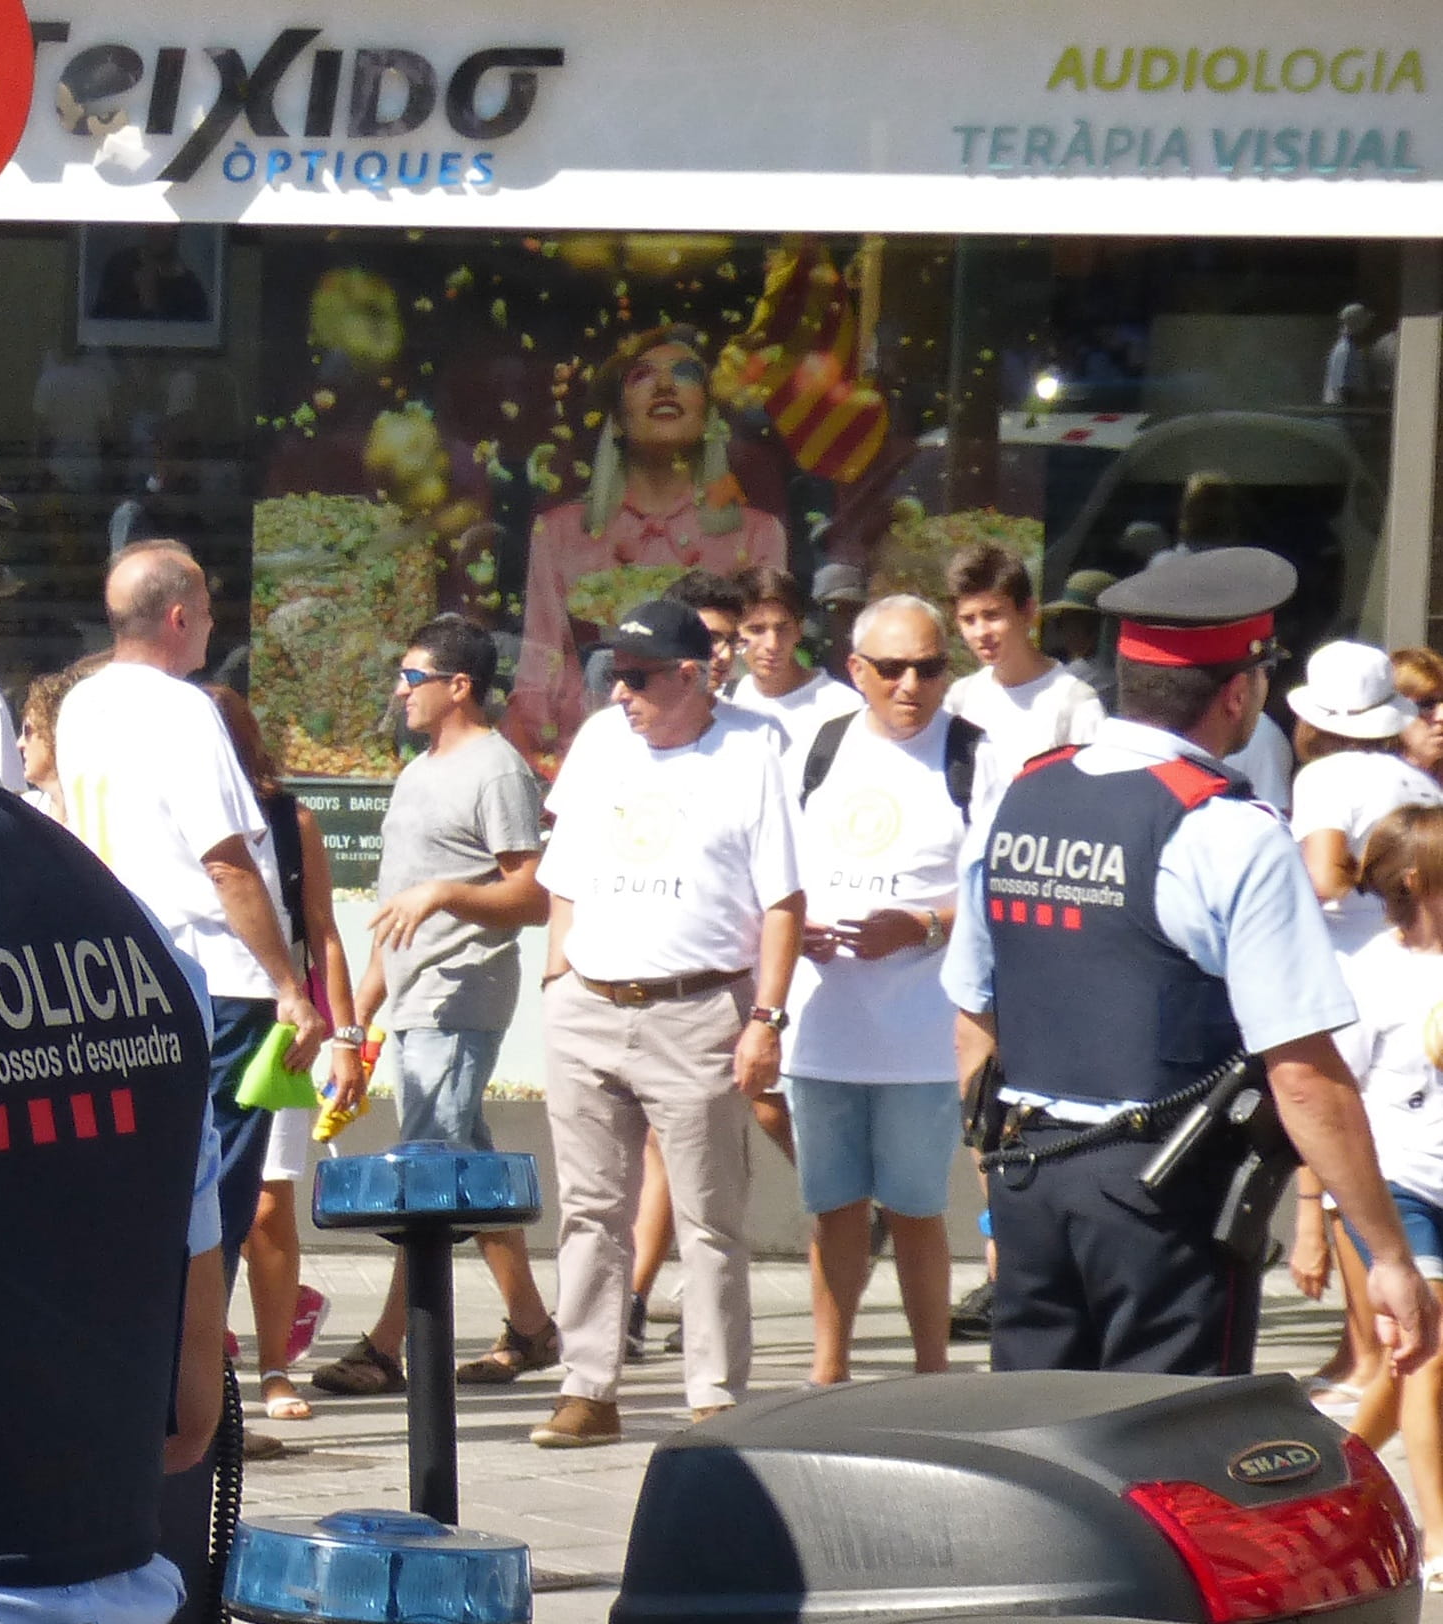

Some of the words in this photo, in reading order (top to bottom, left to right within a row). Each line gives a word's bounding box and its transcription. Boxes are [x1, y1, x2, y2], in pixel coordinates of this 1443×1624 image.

[1045, 47, 1426, 94] AUDIOLOGIA
[223, 142, 496, 187] ÒPTIQUES
[953, 119, 1191, 171] TERÀPIA
[1214, 129, 1419, 173] VISUAL
[990, 831, 1126, 886] POLICIA
[990, 876, 1039, 898] mossos
